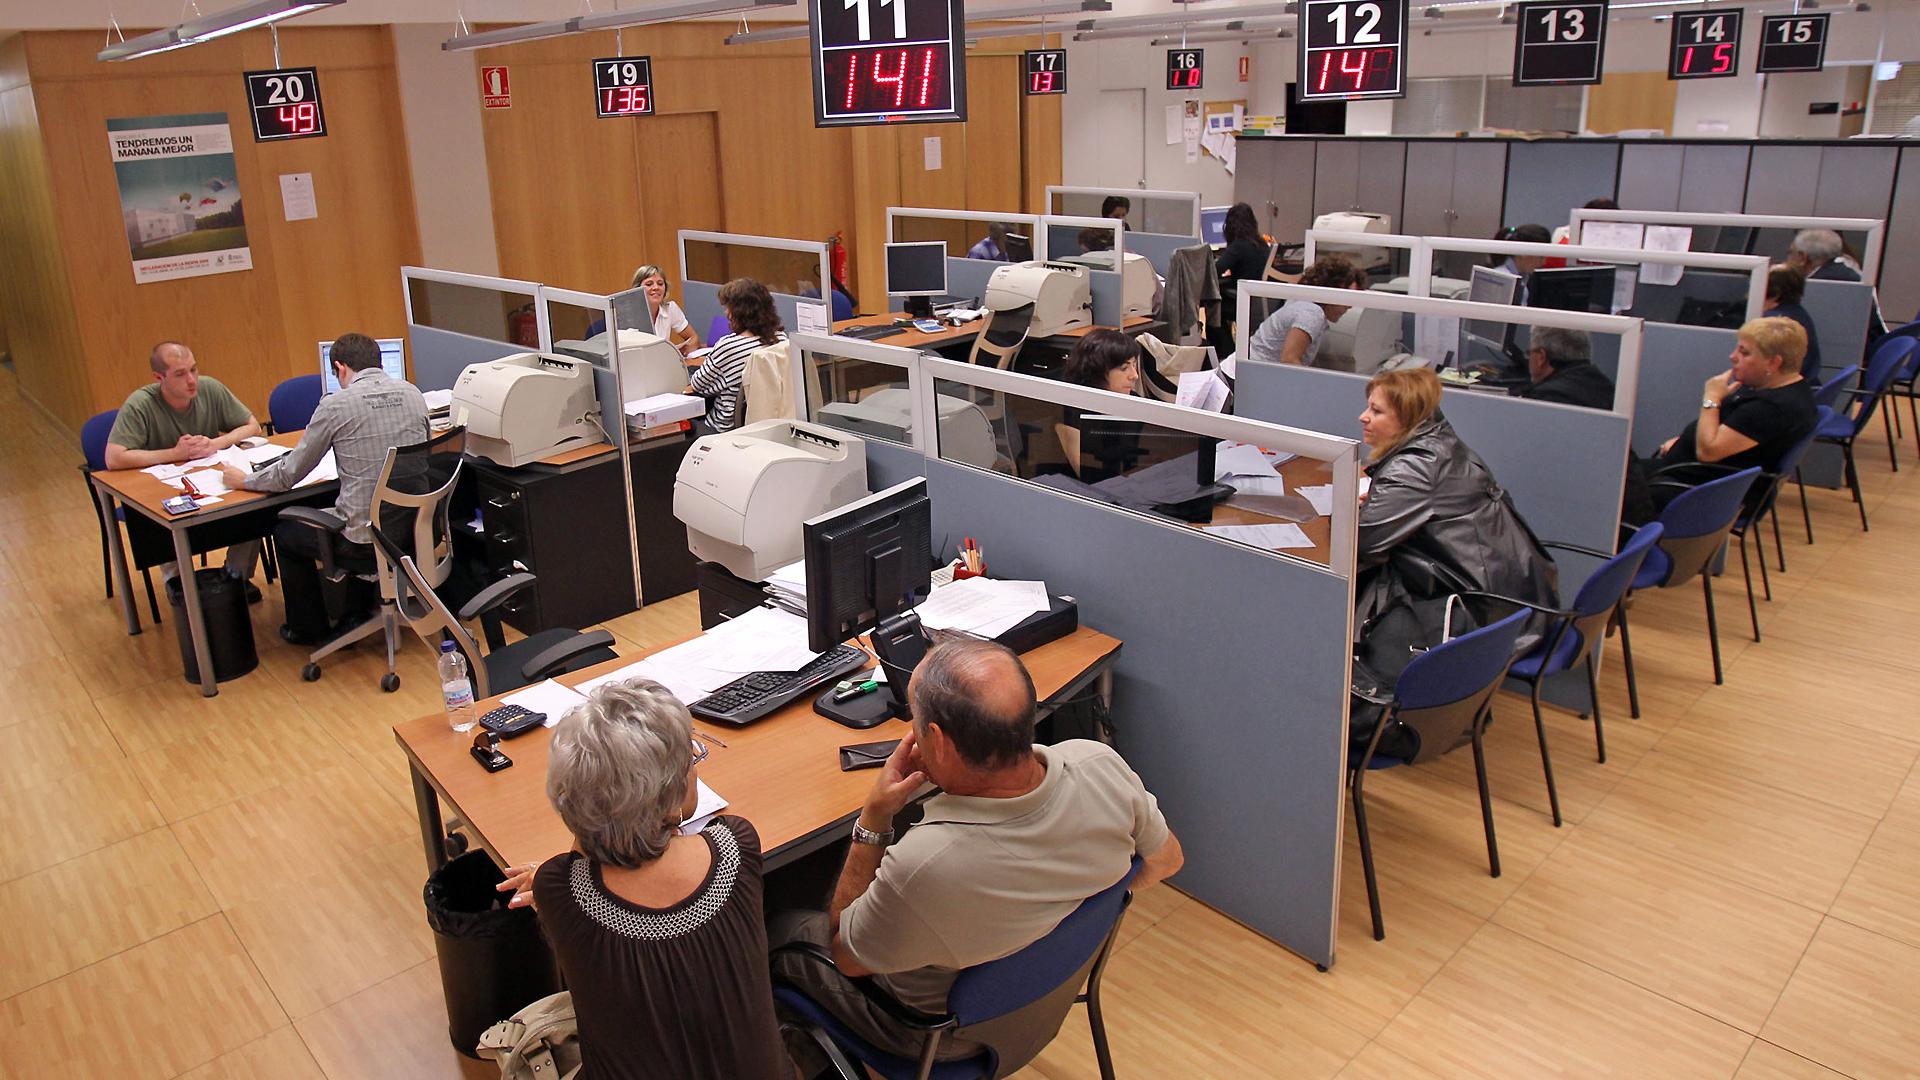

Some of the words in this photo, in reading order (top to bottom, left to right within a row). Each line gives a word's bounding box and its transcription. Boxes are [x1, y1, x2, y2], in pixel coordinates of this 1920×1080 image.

[844, 0, 907, 41] 11
[1327, 3, 1381, 44] 12
[1541, 9, 1585, 41] 13
[1690, 16, 1725, 42] 14
[1777, 20, 1812, 43] 15
[1036, 54, 1057, 71] 17
[1177, 53, 1195, 68] 16
[607, 63, 638, 86] 19
[846, 50, 932, 109] 141
[1033, 72, 1053, 91] 13
[265, 76, 304, 104] 20
[607, 87, 646, 112] 136
[279, 104, 314, 132] 49
[116, 136, 178, 149] TENDREMOS
[179, 135, 193, 144] UN
[162, 144, 195, 154] MEJOR
